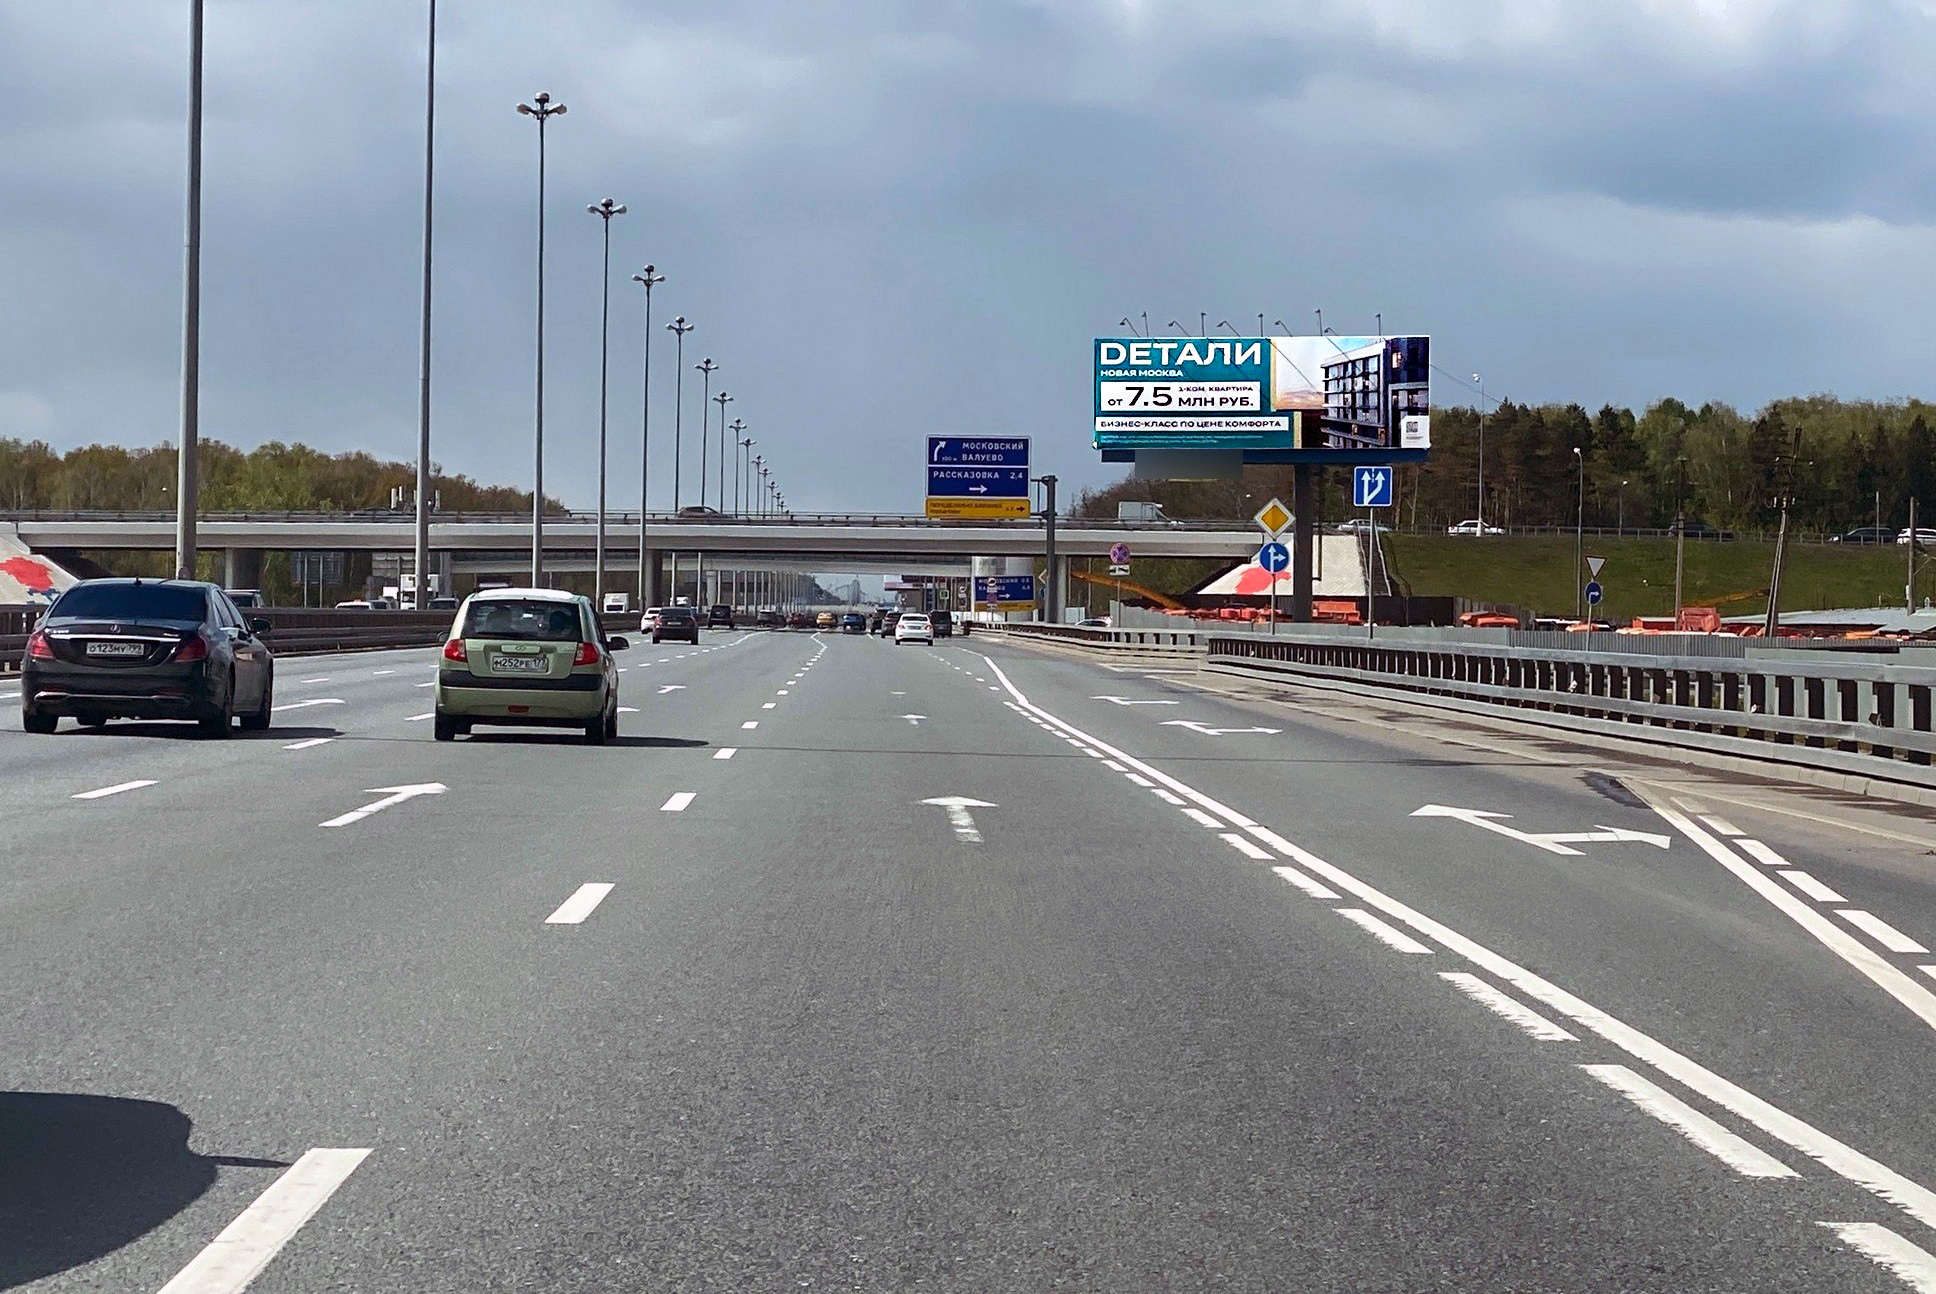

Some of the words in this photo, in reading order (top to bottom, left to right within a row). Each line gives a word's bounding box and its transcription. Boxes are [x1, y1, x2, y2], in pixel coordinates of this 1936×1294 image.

[1126, 387, 1172, 406] 7.5
[1179, 397, 1215, 407] МЛН
[1220, 397, 1254, 407] РУБ.
[1197, 421, 1224, 429] ЦЕНЕ
[962, 442, 1024, 450] МОСКОВСКИЙ
[962, 454, 1003, 462] ВАЛУЕВО
[933, 471, 1000, 479] РАССКАЗОВКА
